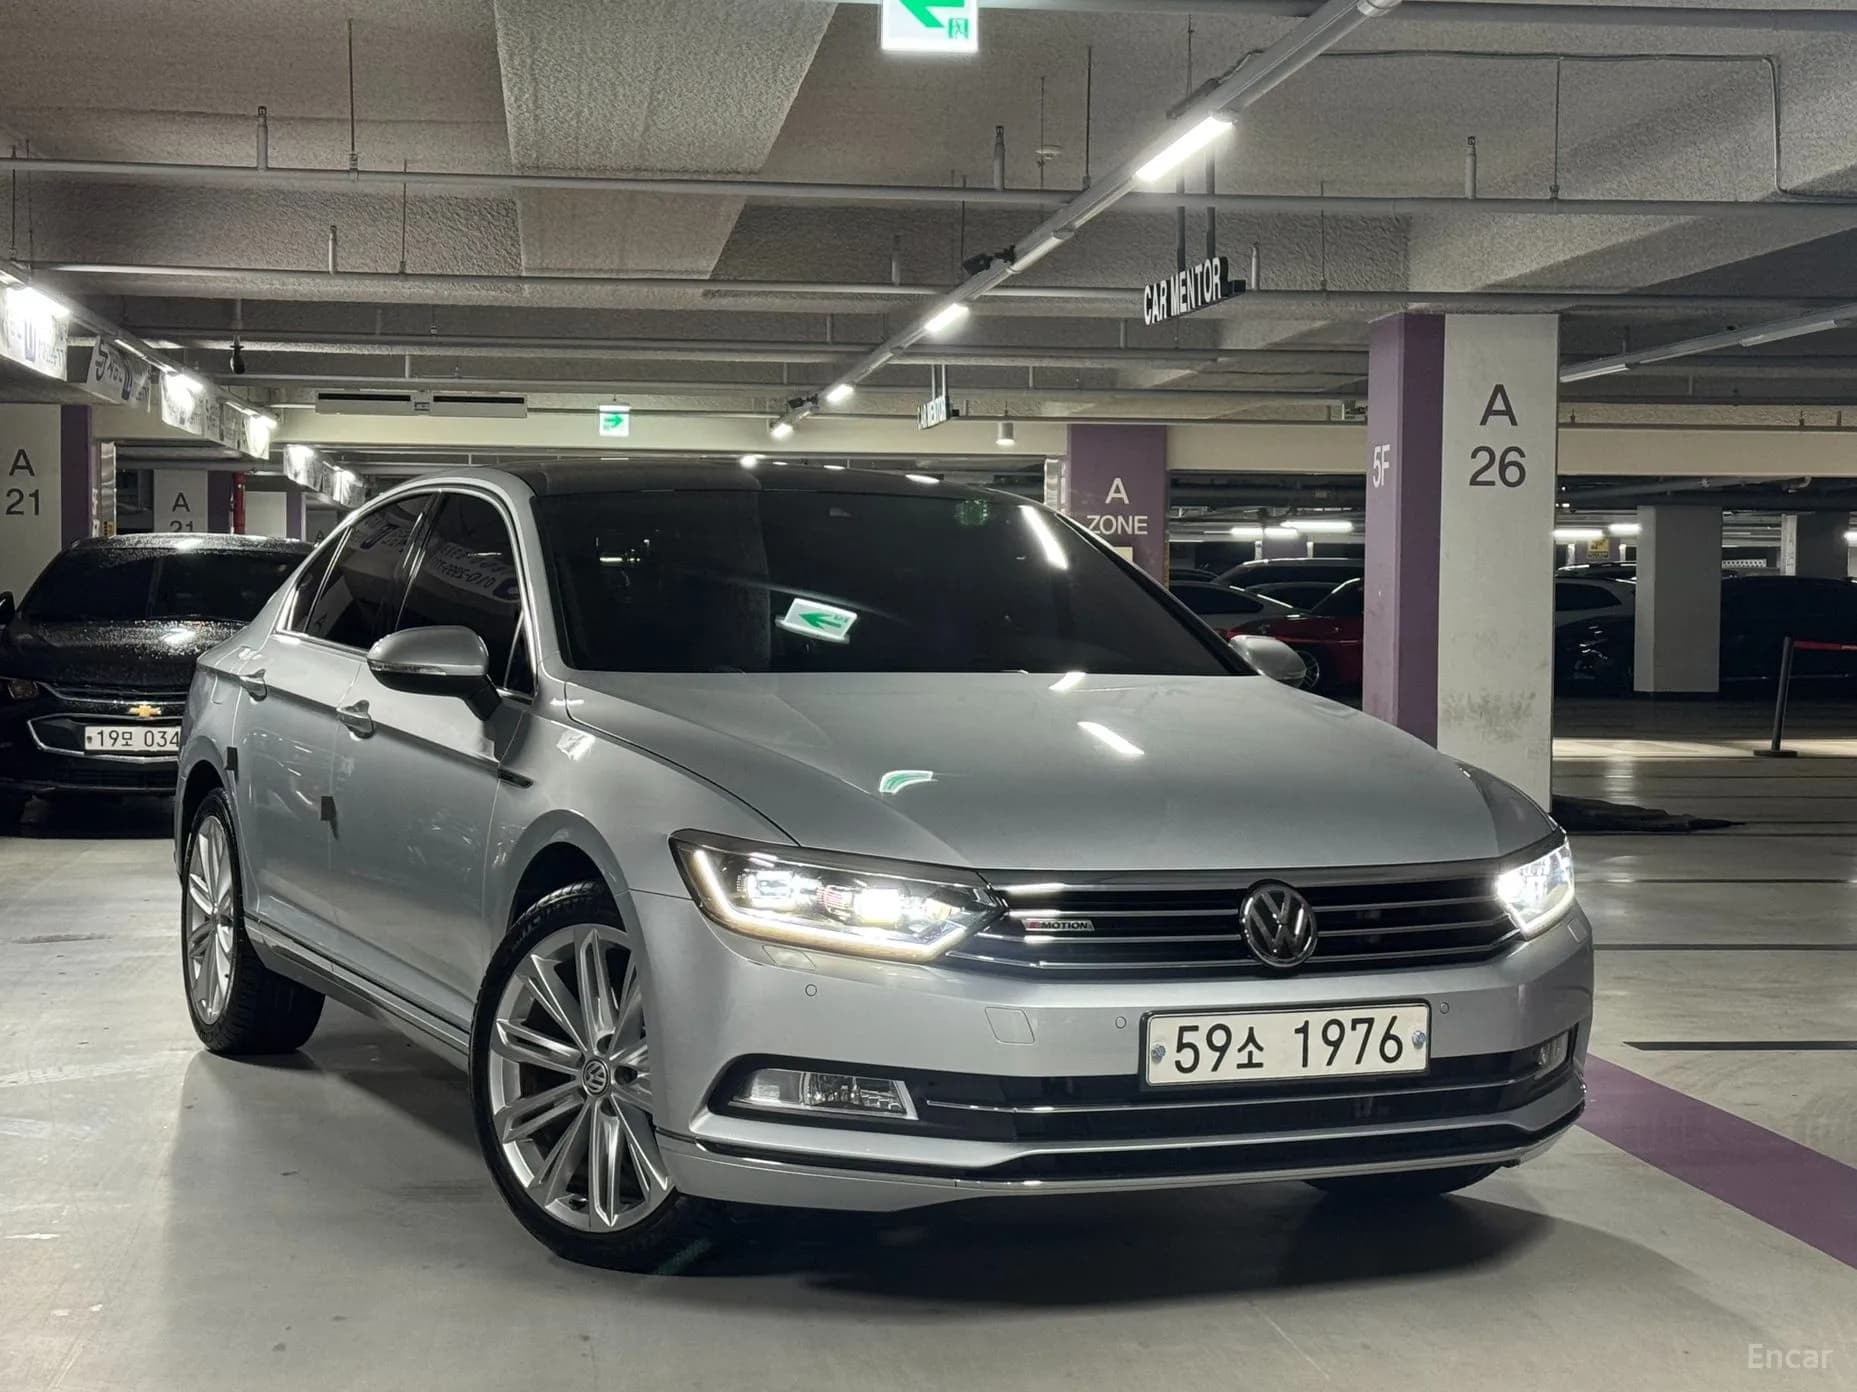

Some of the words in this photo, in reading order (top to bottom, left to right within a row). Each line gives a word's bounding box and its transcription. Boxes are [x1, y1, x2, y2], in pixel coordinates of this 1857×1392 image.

[1144, 280, 1167, 326] CAR
[1171, 257, 1221, 316] MENTOR
[1480, 384, 1518, 426] A
[9, 448, 35, 476] A
[1372, 444, 1390, 488] 5F
[1469, 446, 1526, 487] 26
[6, 488, 40, 515] 21
[172, 492, 190, 513] A
[1105, 478, 1130, 504] A
[1086, 515, 1148, 535] ZONE
[97, 729, 133, 747] 19모
[1173, 1023, 1265, 1074] 59소
[1294, 1015, 1404, 1068] 1976
